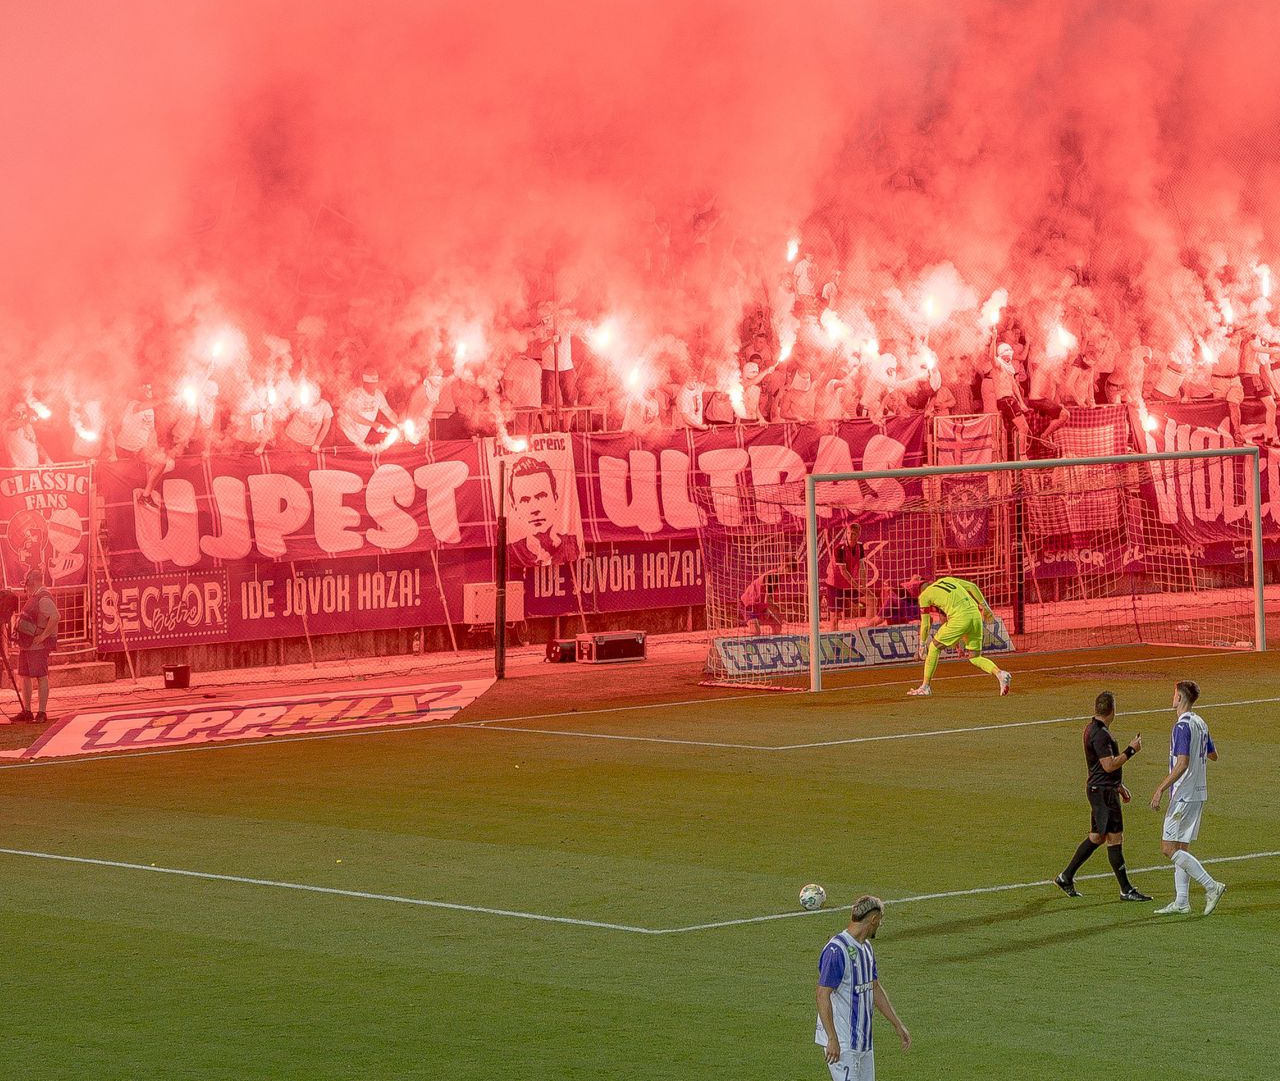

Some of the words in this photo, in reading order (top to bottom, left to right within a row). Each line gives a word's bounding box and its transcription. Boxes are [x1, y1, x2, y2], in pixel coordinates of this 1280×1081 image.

[0, 472, 89, 501] CLASSIC
[24, 493, 68, 511] FANS
[598, 433, 907, 533] ULTRAS
[241, 580, 275, 620] IDE
[282, 570, 350, 617] JÖVÖK
[358, 568, 420, 611] HAZA!
[534, 563, 566, 598] IDE
[573, 552, 635, 595] JÖVÖK
[642, 550, 702, 589] HAZA!
[101, 581, 223, 633] SECTOR
[152, 600, 198, 632] Bistro
